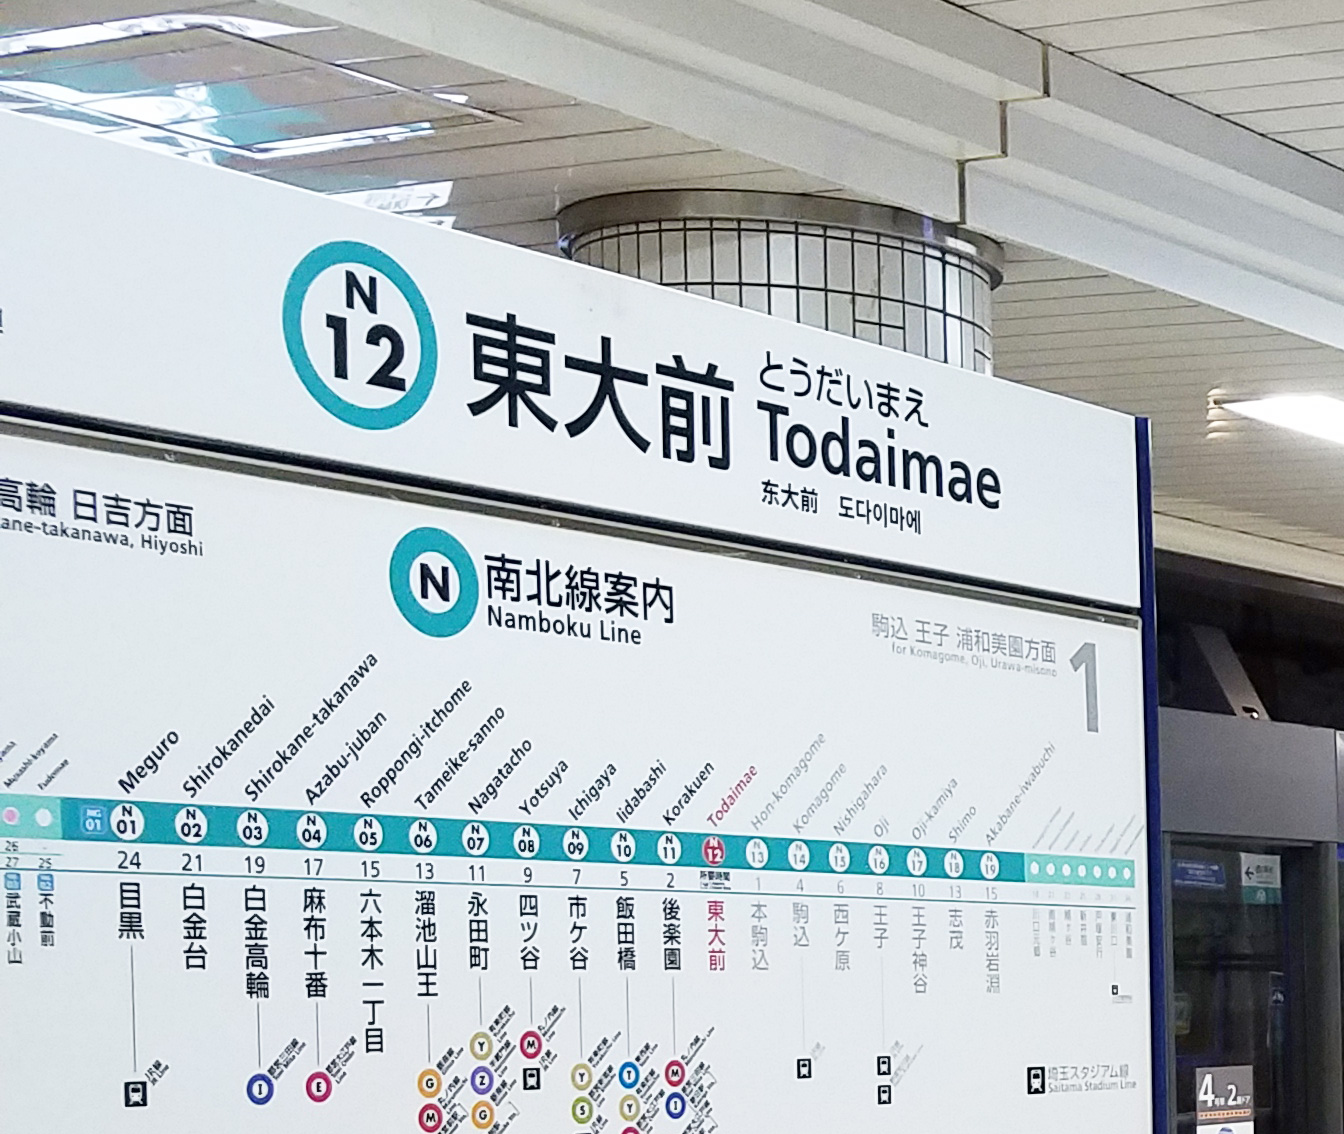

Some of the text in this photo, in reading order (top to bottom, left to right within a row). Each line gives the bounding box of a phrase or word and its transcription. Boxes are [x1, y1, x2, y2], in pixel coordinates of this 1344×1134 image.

[345, 271, 377, 314] N
[325, 314, 406, 391] 12
[465, 312, 734, 470] 東大前
[759, 351, 929, 428] とうだいまえ
[757, 400, 1002, 509] Todaimae
[73, 488, 194, 537] 日吉方面
[761, 479, 818, 514] 东大前
[838, 496, 922, 536] 도다이마에
[140, 533, 204, 556] Hiyoshi
[419, 561, 451, 602] N
[484, 553, 674, 624] 南北線案内
[486, 605, 642, 646] Namboku Line
[872, 613, 909, 641] 駒込
[915, 619, 950, 648] 王子
[1070, 642, 1099, 733] 1
[183, 694, 276, 798] Shirokanedai
[245, 652, 378, 802] Shirokane-takanawa
[359, 679, 472, 809] Roppongi-itchome
[118, 731, 180, 794] Meguro
[304, 710, 388, 806] Azabu-juban
[413, 706, 505, 811] Tameike-sanno
[468, 739, 532, 815] Nagatacho
[518, 759, 568, 816] Yotsuya
[568, 762, 617, 821] Ichigaya
[616, 759, 667, 824] Iidabashi
[662, 761, 715, 827] Korakuen
[706, 764, 758, 828] Todaimae
[117, 820, 136, 835] 01
[181, 824, 202, 838] 02
[243, 826, 262, 841] 03
[302, 829, 321, 843] 04
[359, 832, 377, 846] 05
[414, 835, 432, 848] 06
[467, 838, 484, 850] 07
[519, 840, 534, 852] 08
[568, 842, 584, 854] 09
[118, 851, 141, 870] 24
[182, 854, 202, 872] 21
[245, 856, 265, 874] 19
[305, 858, 323, 875] 17
[361, 861, 380, 878] 15
[416, 863, 434, 879] 13
[617, 845, 631, 857] 10
[663, 847, 676, 860] 11
[706, 849, 722, 862] 12
[751, 852, 764, 864] 13
[469, 865, 485, 881] 11
[524, 867, 532, 883] 9
[572, 869, 581, 884] 7
[620, 872, 628, 886] 5
[667, 873, 675, 888] 2
[118, 882, 144, 940] 目黒
[183, 883, 208, 970] 白金台
[468, 892, 490, 971] 永田町
[520, 894, 540, 970] 四ツ谷
[793, 903, 810, 947] 駒込
[874, 906, 888, 949] 王子
[950, 908, 963, 949] 志茂
[244, 885, 269, 999] 白金高輪
[303, 887, 328, 998] 麻布十番
[415, 890, 438, 997] 溜池山王
[616, 896, 636, 971] 飯田橋
[662, 898, 681, 971] 後楽園
[708, 901, 726, 971] 東大前
[751, 902, 769, 971] 本駒込
[912, 906, 928, 993] 王子神谷
[360, 889, 384, 1053] 六本木一丁目
